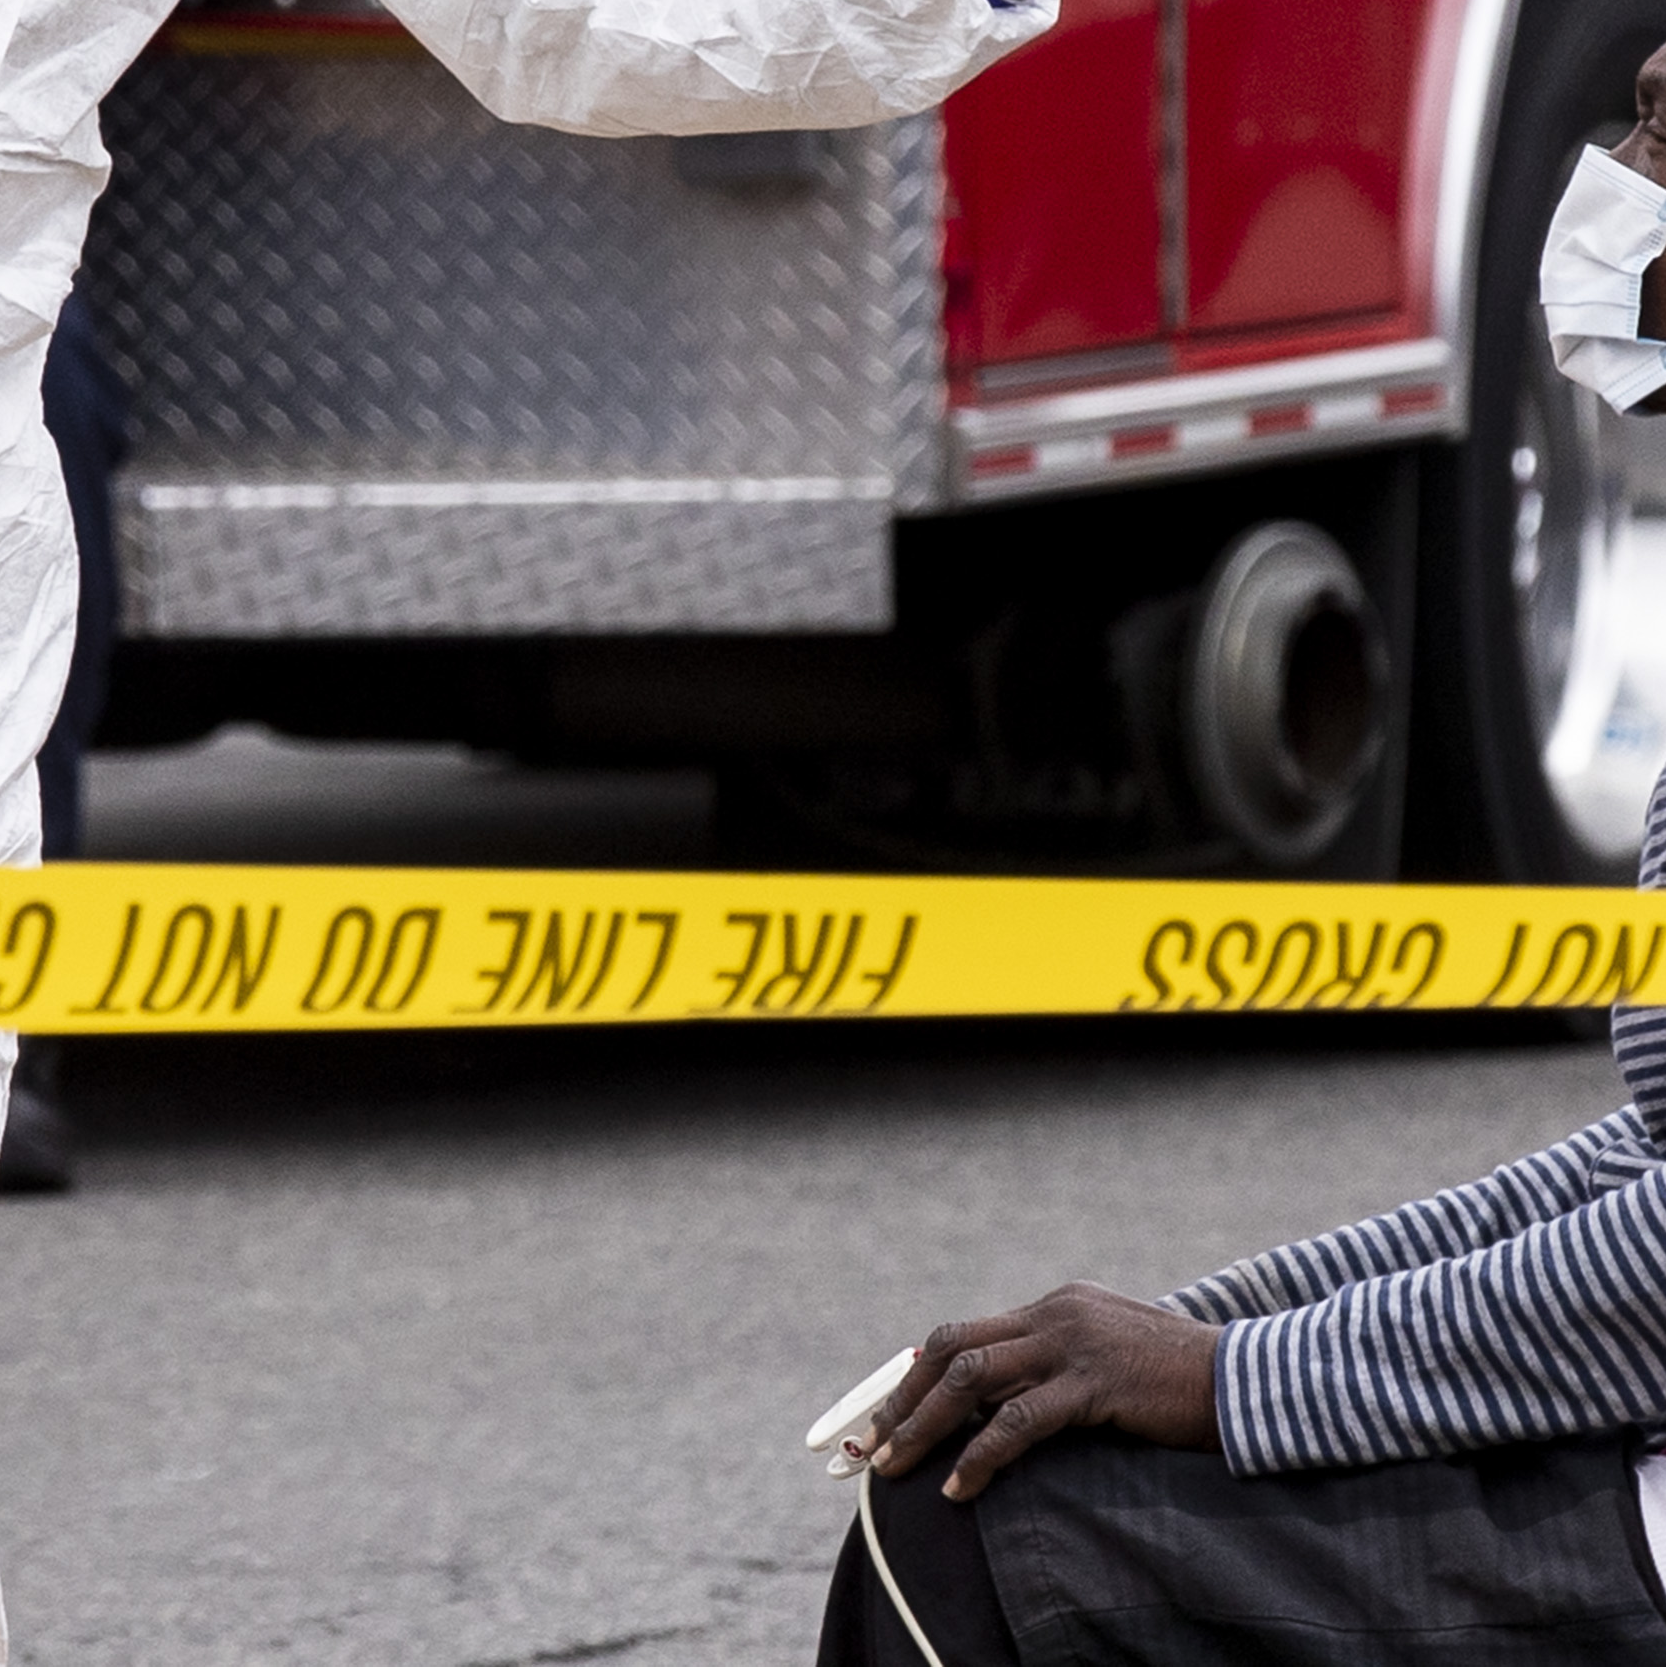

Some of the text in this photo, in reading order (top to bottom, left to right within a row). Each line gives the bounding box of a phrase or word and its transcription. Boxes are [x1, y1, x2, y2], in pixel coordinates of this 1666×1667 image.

[66, 902, 283, 1016] NOT
[299, 906, 444, 1014] DO
[450, 909, 681, 1014] LINE
[688, 912, 920, 1017] FIRE
[1117, 918, 1451, 1011] CROSS
